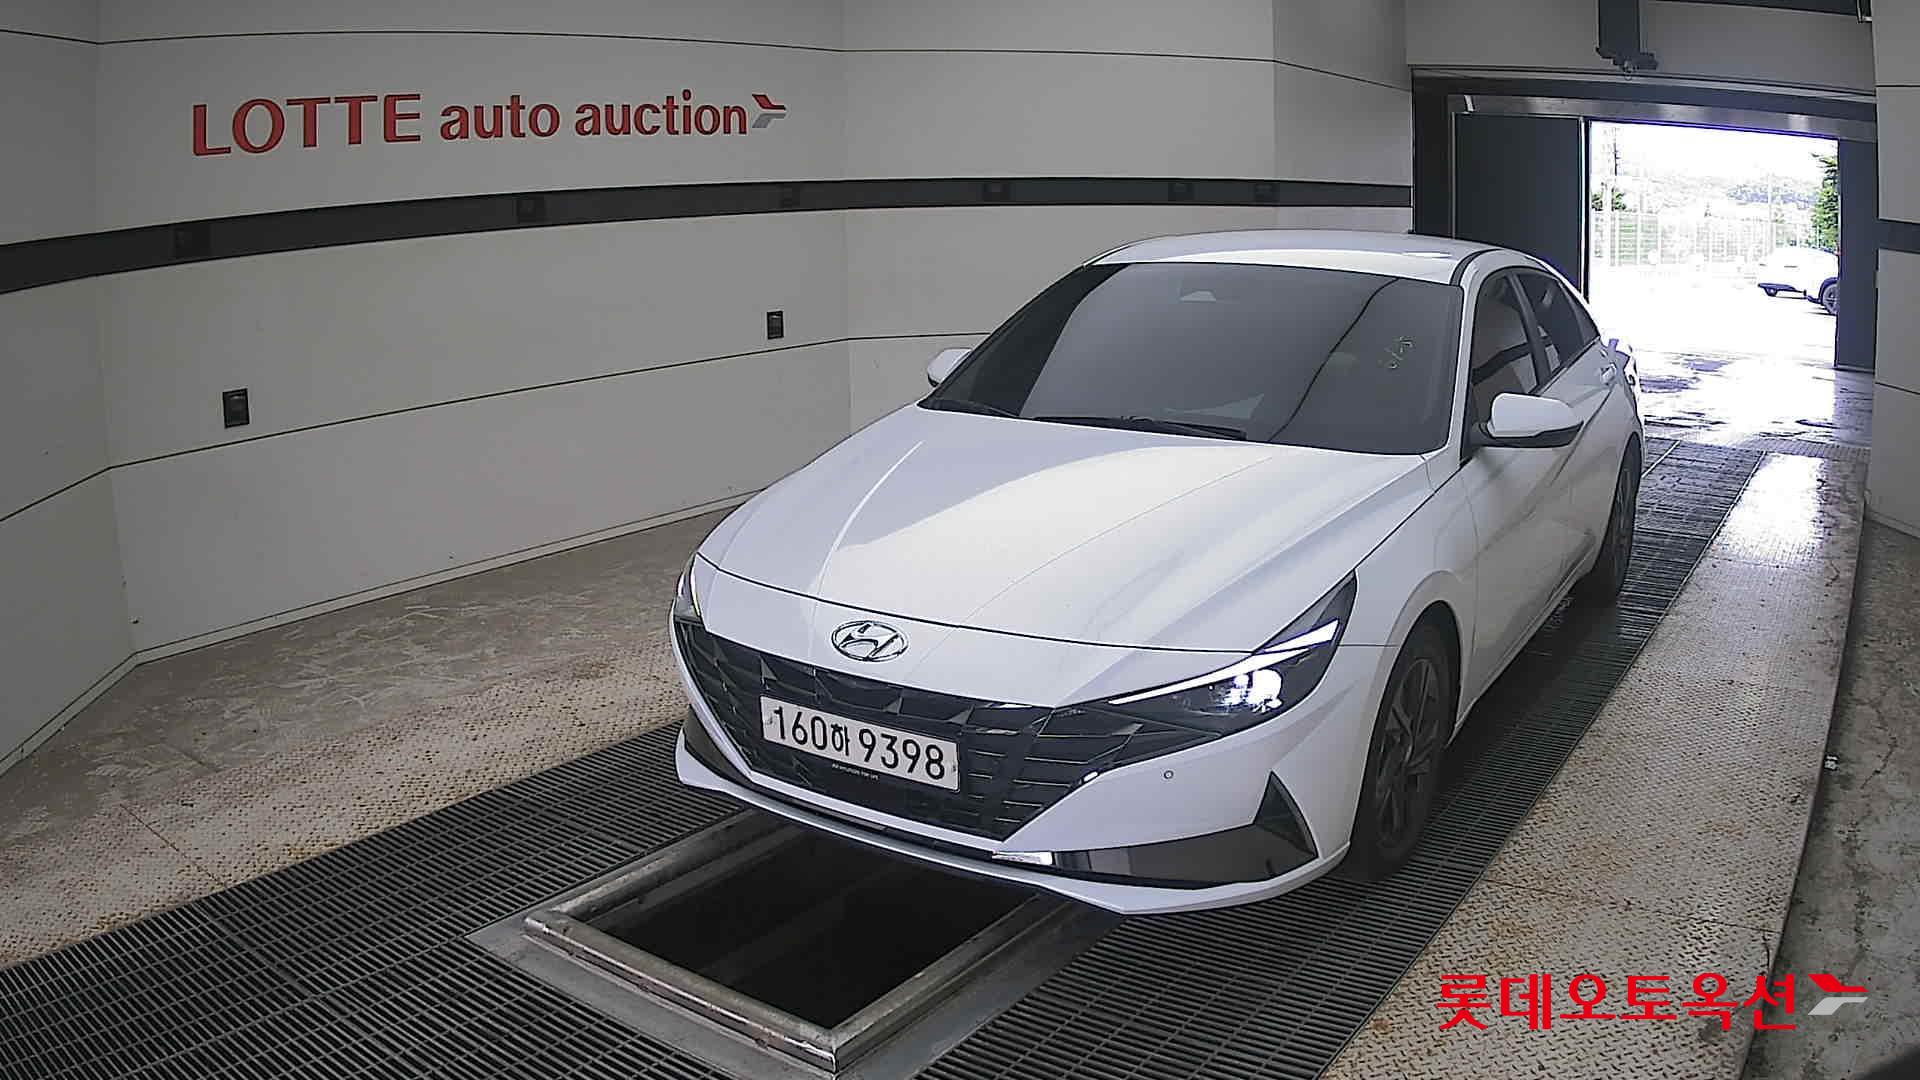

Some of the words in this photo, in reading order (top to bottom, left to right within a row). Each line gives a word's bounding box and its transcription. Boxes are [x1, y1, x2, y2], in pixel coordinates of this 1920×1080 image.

[193, 94, 421, 156] LOTTE
[440, 94, 560, 140] auto
[575, 89, 748, 136] auction
